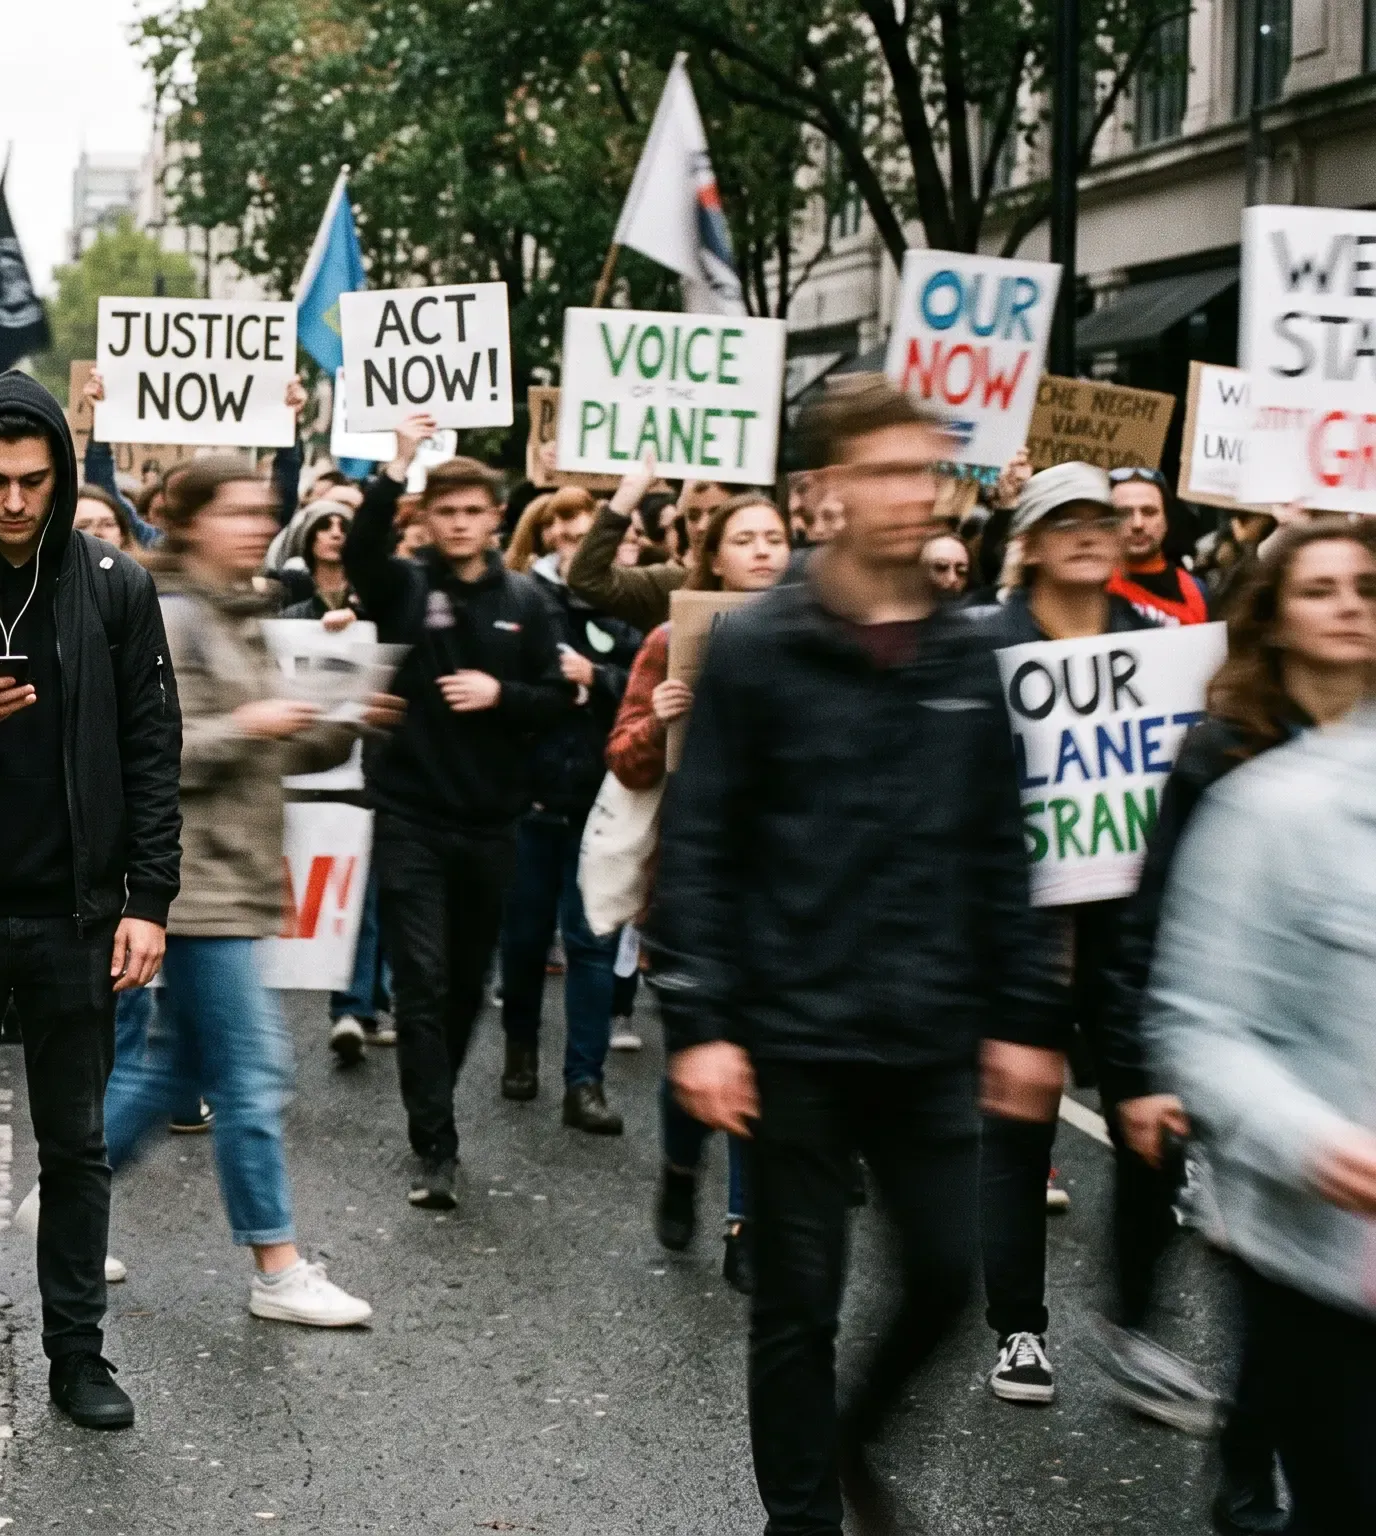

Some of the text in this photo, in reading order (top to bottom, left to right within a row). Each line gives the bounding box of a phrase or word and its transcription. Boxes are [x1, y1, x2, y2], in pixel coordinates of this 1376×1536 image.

[108, 311, 285, 361] JUSTICE
[374, 293, 477, 348] ACT
[920, 269, 1040, 342] OUR
[364, 347, 498, 408] NOW!
[599, 322, 745, 385] VOICE
[899, 337, 1032, 410] NOW
[138, 371, 254, 422] NOW
[579, 399, 760, 469] PLANET
[1009, 649, 1145, 721] OUR
